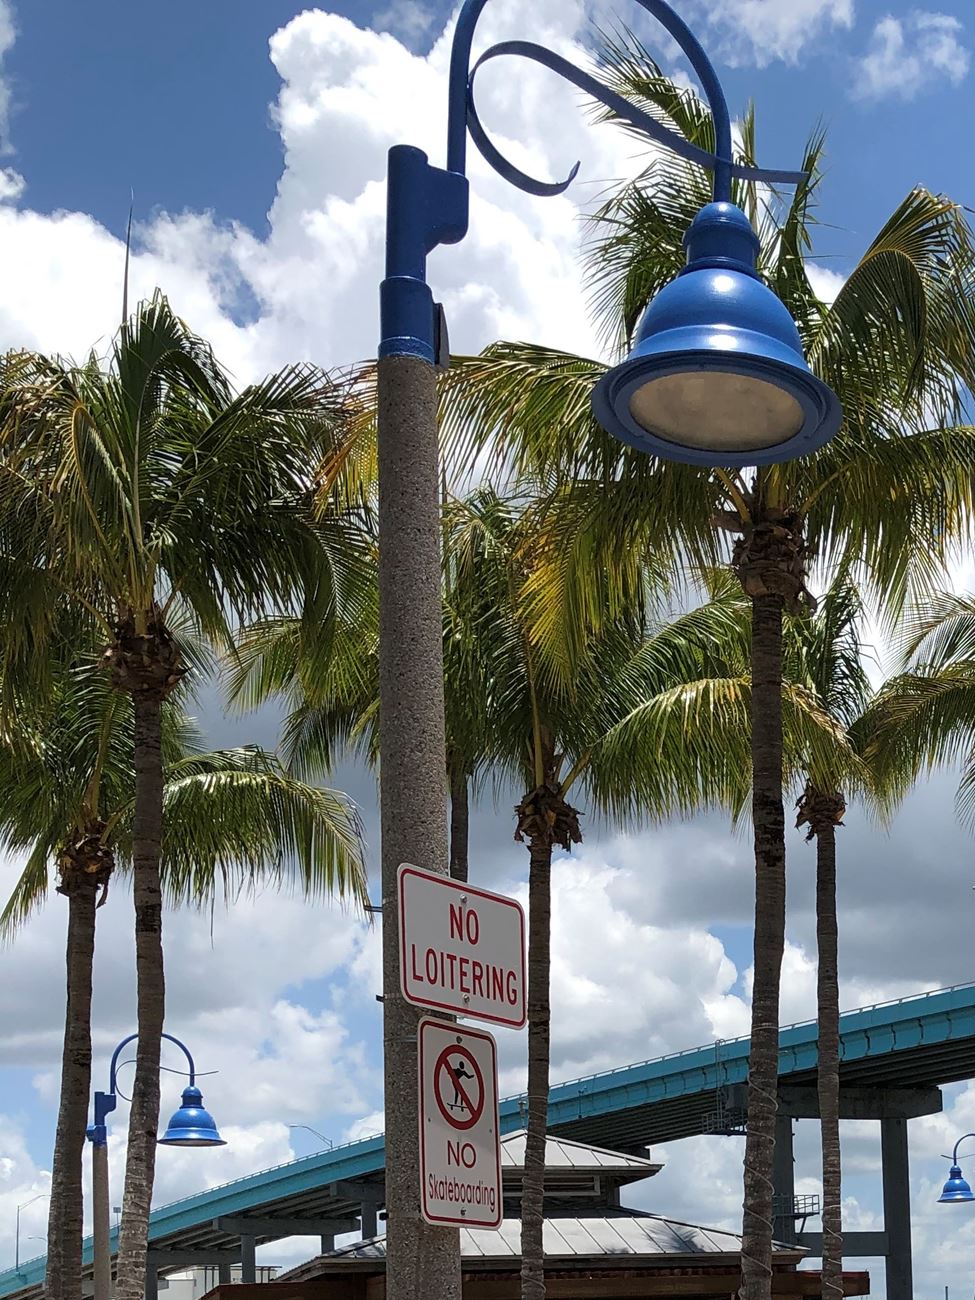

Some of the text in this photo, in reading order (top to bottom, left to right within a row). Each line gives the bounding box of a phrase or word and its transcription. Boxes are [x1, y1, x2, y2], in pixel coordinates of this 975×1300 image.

[449, 903, 479, 945] NO
[411, 943, 517, 1005] LOITERING
[447, 1140, 476, 1169] NO
[428, 1172, 496, 1213] Skateboarding
